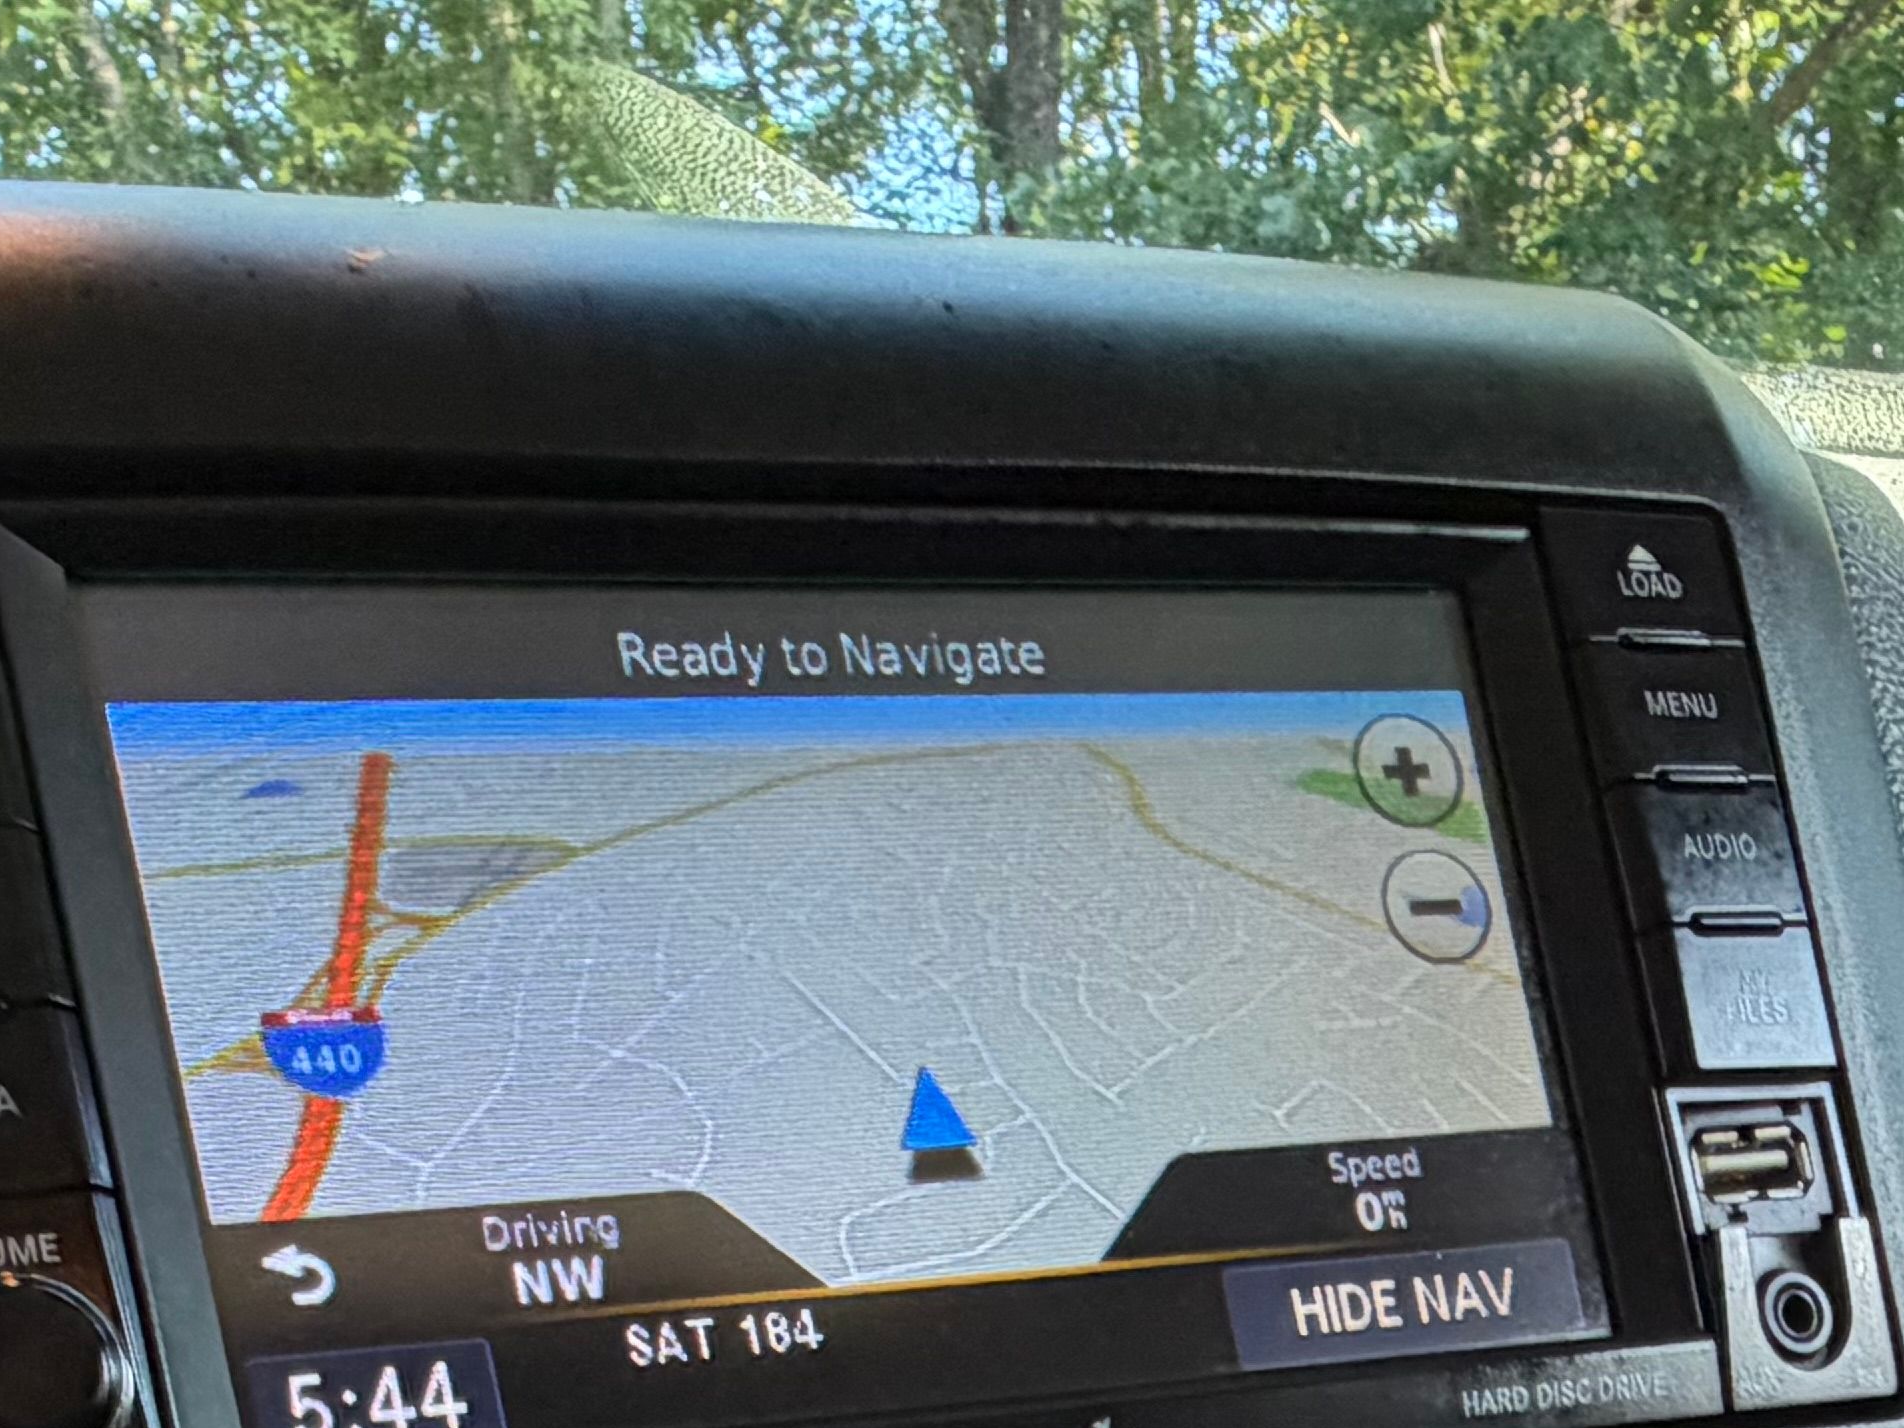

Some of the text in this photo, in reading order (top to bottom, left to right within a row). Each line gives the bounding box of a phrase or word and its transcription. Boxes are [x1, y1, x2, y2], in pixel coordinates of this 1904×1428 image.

[1617, 571, 1684, 599] LOAD
[617, 631, 1047, 686] Ready to Navigate
[1643, 690, 1718, 720] MENU
[1683, 833, 1757, 860] AUDIO
[290, 1043, 363, 1075] 440
[1327, 1145, 1425, 1188] Speed
[481, 1209, 621, 1253] Driving
[513, 1255, 606, 1306] NW
[1291, 1267, 1515, 1337] HIDE NAV
[625, 1308, 825, 1368] SAT 184
[1461, 1373, 1669, 1419] HARD DISC DRIVE
